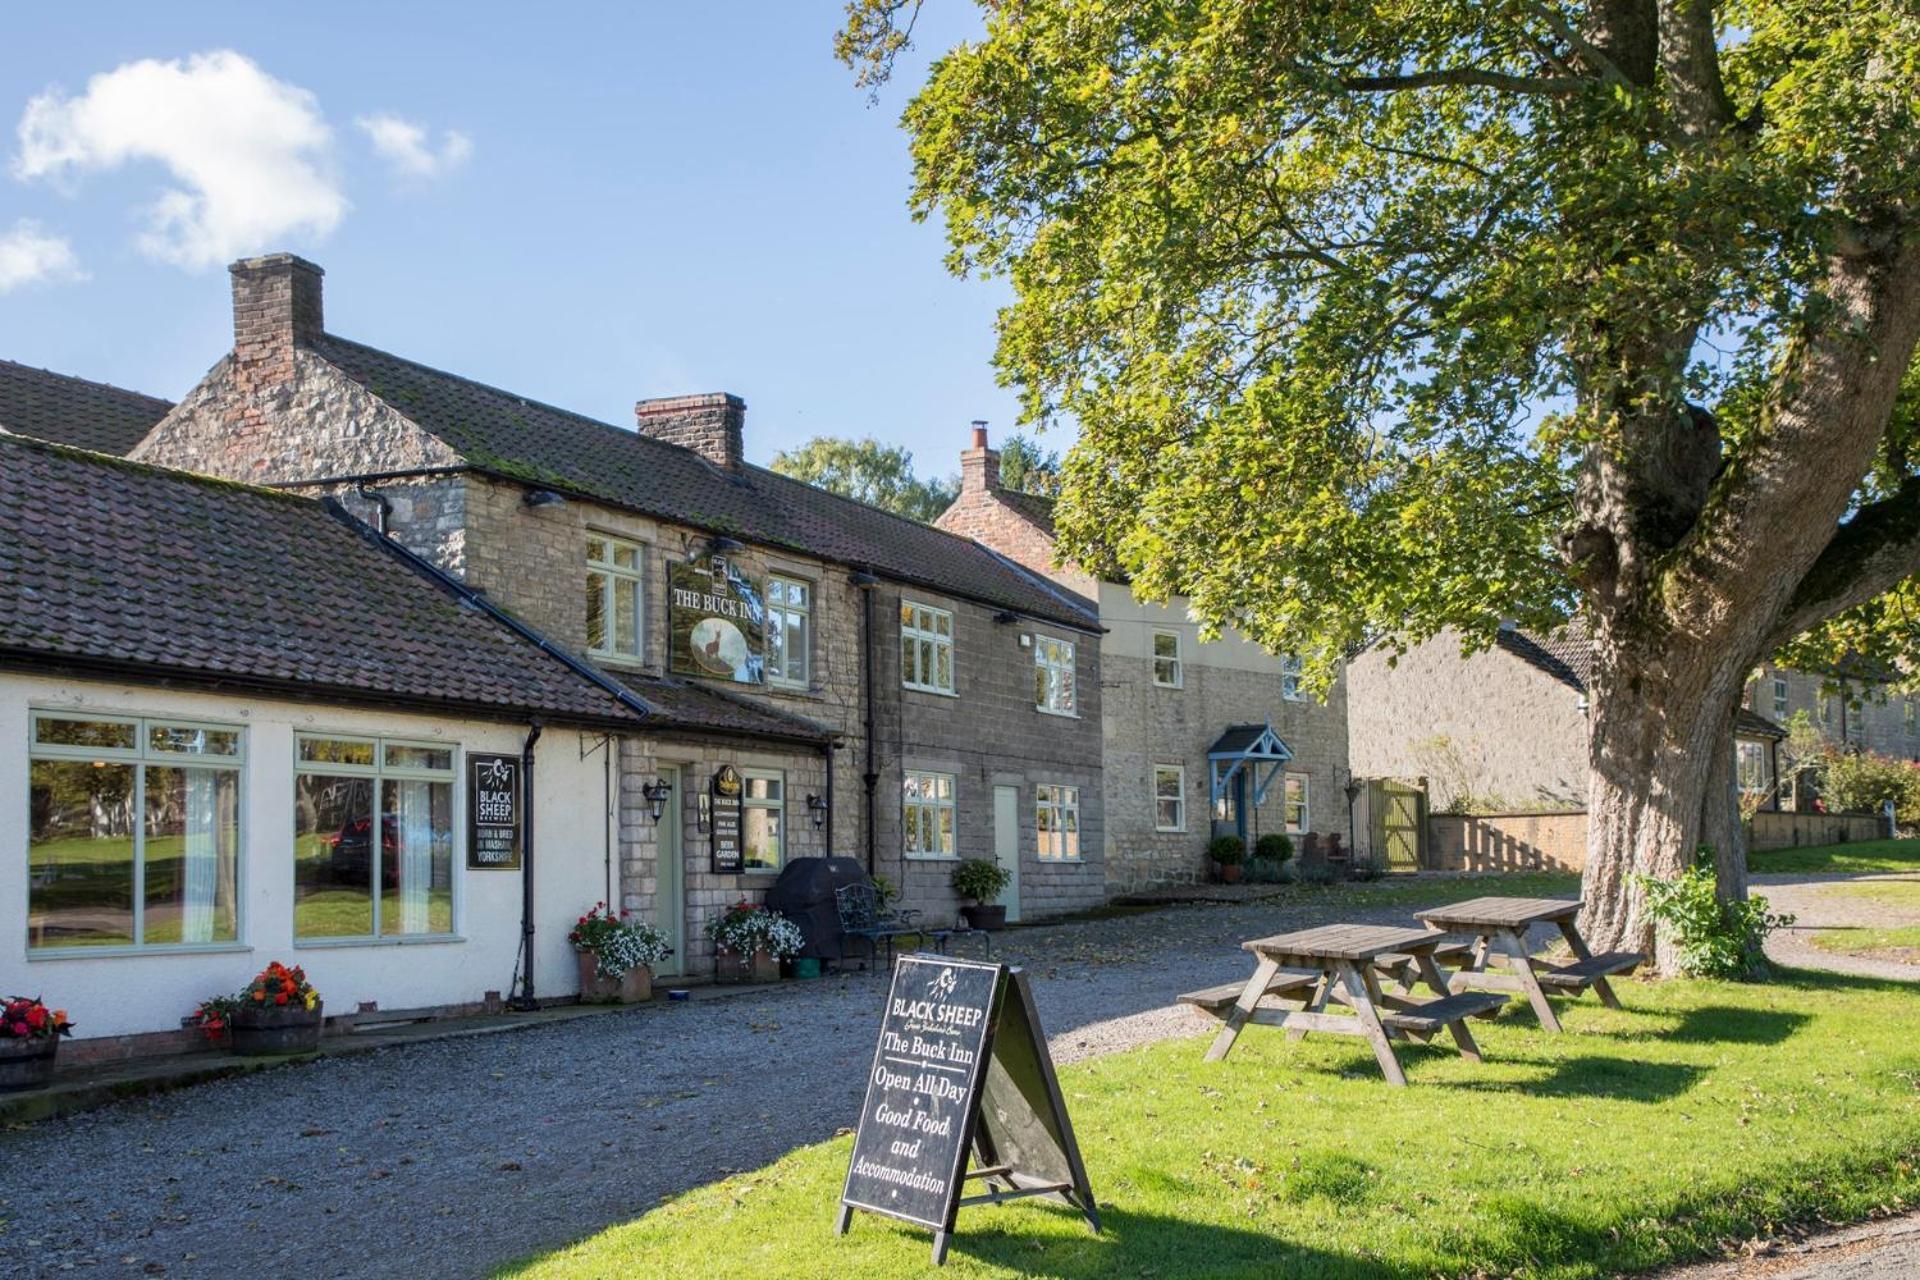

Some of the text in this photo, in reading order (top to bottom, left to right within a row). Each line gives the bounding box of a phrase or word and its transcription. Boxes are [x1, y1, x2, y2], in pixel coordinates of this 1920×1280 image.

[674, 588, 700, 609] THE
[703, 594, 737, 617] BUCK
[479, 790, 512, 804] BLACK
[479, 803, 512, 816] SHEEP
[477, 851, 513, 863] YORKSHIRE
[485, 839, 512, 850] MASH
[716, 850, 739, 859] GARDEN
[892, 998, 936, 1022] BLACK
[937, 1004, 982, 1027] SHEEP
[884, 1032, 974, 1065] The Buck Inn
[875, 1065, 968, 1105] Open All Day
[875, 1103, 951, 1136] Good Food
[891, 1138, 921, 1159] and
[853, 1155, 945, 1195] Accommodation
